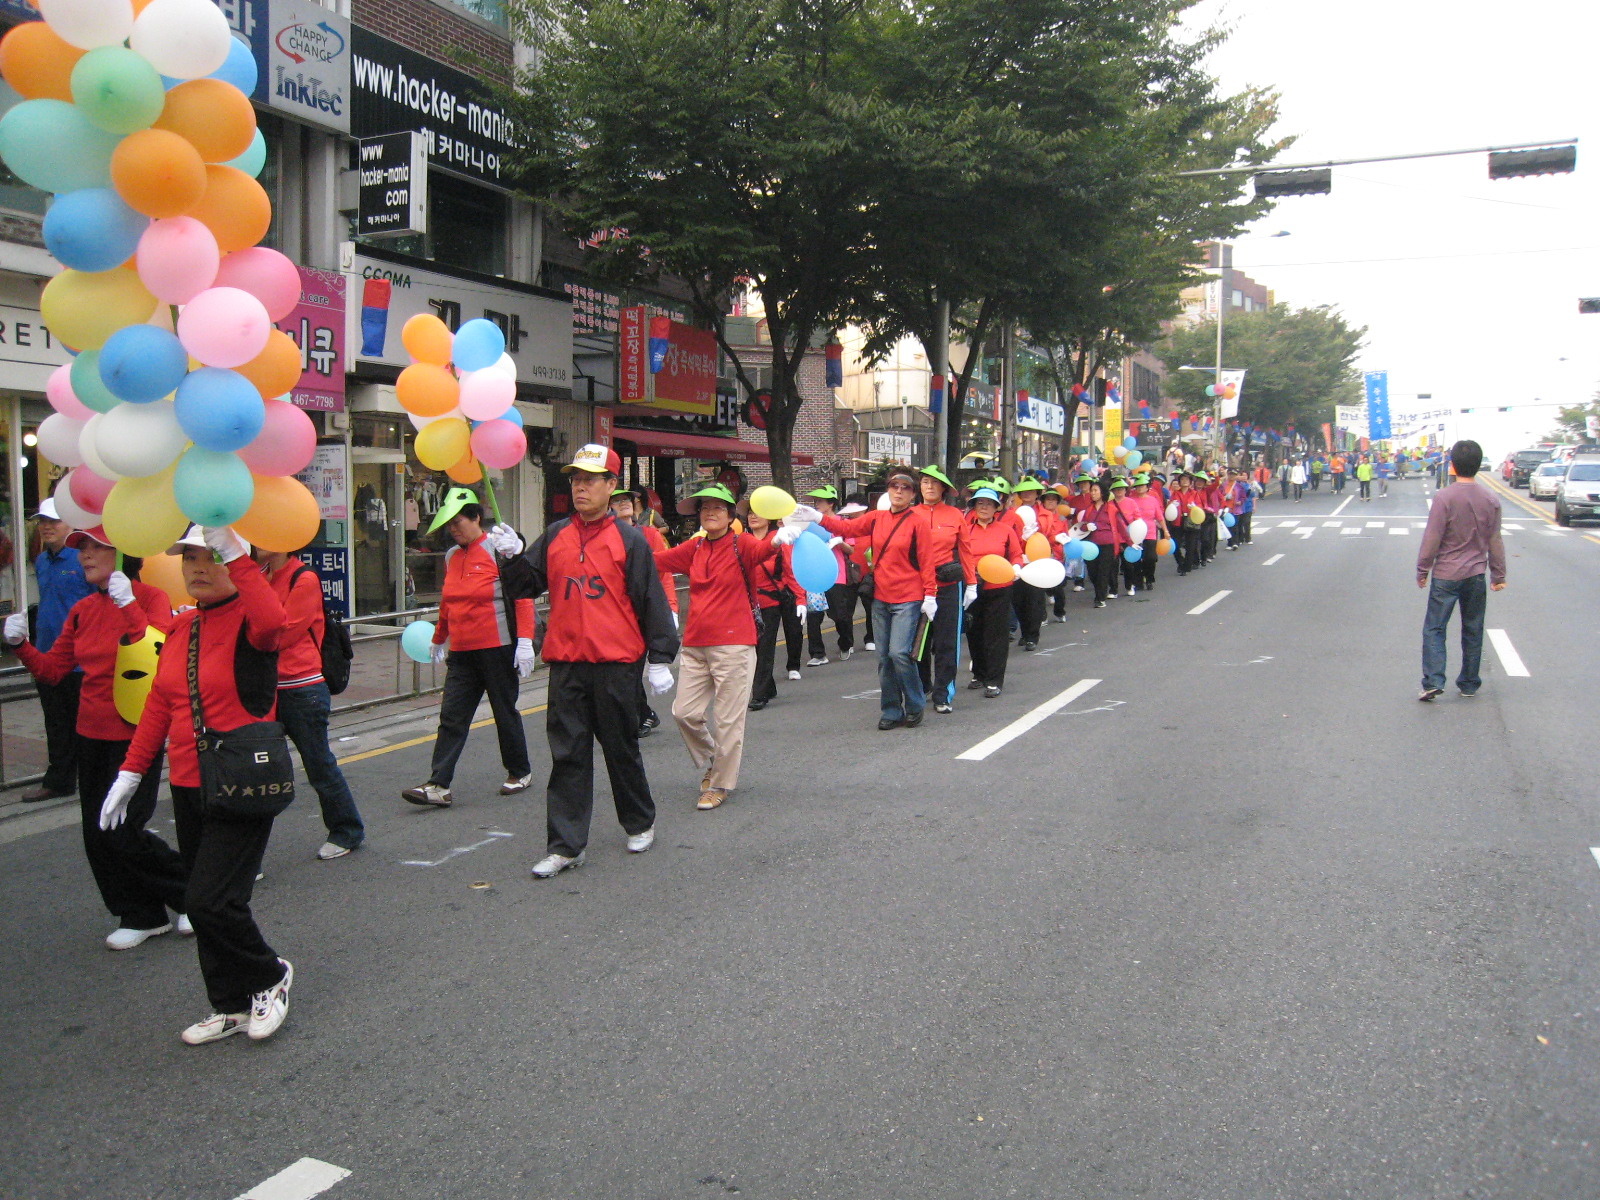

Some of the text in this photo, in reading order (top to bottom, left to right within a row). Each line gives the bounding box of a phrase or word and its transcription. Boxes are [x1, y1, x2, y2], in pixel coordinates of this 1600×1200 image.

[294, 24, 328, 47] HAPPY
[289, 38, 332, 63] CHANGE
[275, 65, 342, 116] InkTec
[361, 144, 384, 162] www
[360, 162, 409, 187] hacker-mania
[386, 189, 408, 206] com
[308, 295, 329, 305] care
[258, 780, 295, 797] 192
